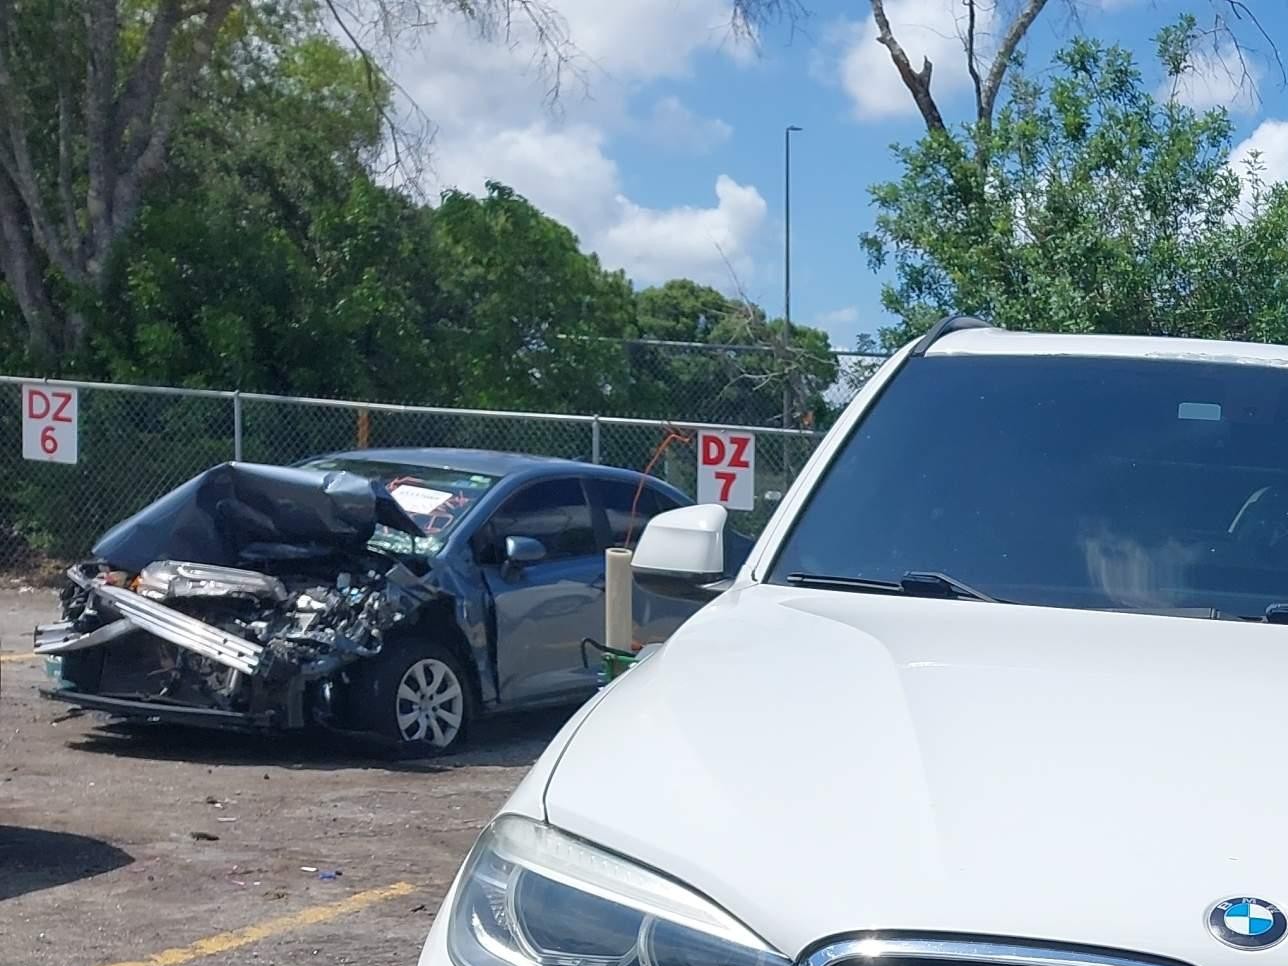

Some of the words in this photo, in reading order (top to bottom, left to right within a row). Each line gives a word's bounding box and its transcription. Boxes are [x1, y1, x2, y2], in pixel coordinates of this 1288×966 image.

[28, 389, 73, 423] DZ
[40, 426, 58, 454] 6
[702, 435, 751, 468] DZ
[714, 471, 737, 502] 7
